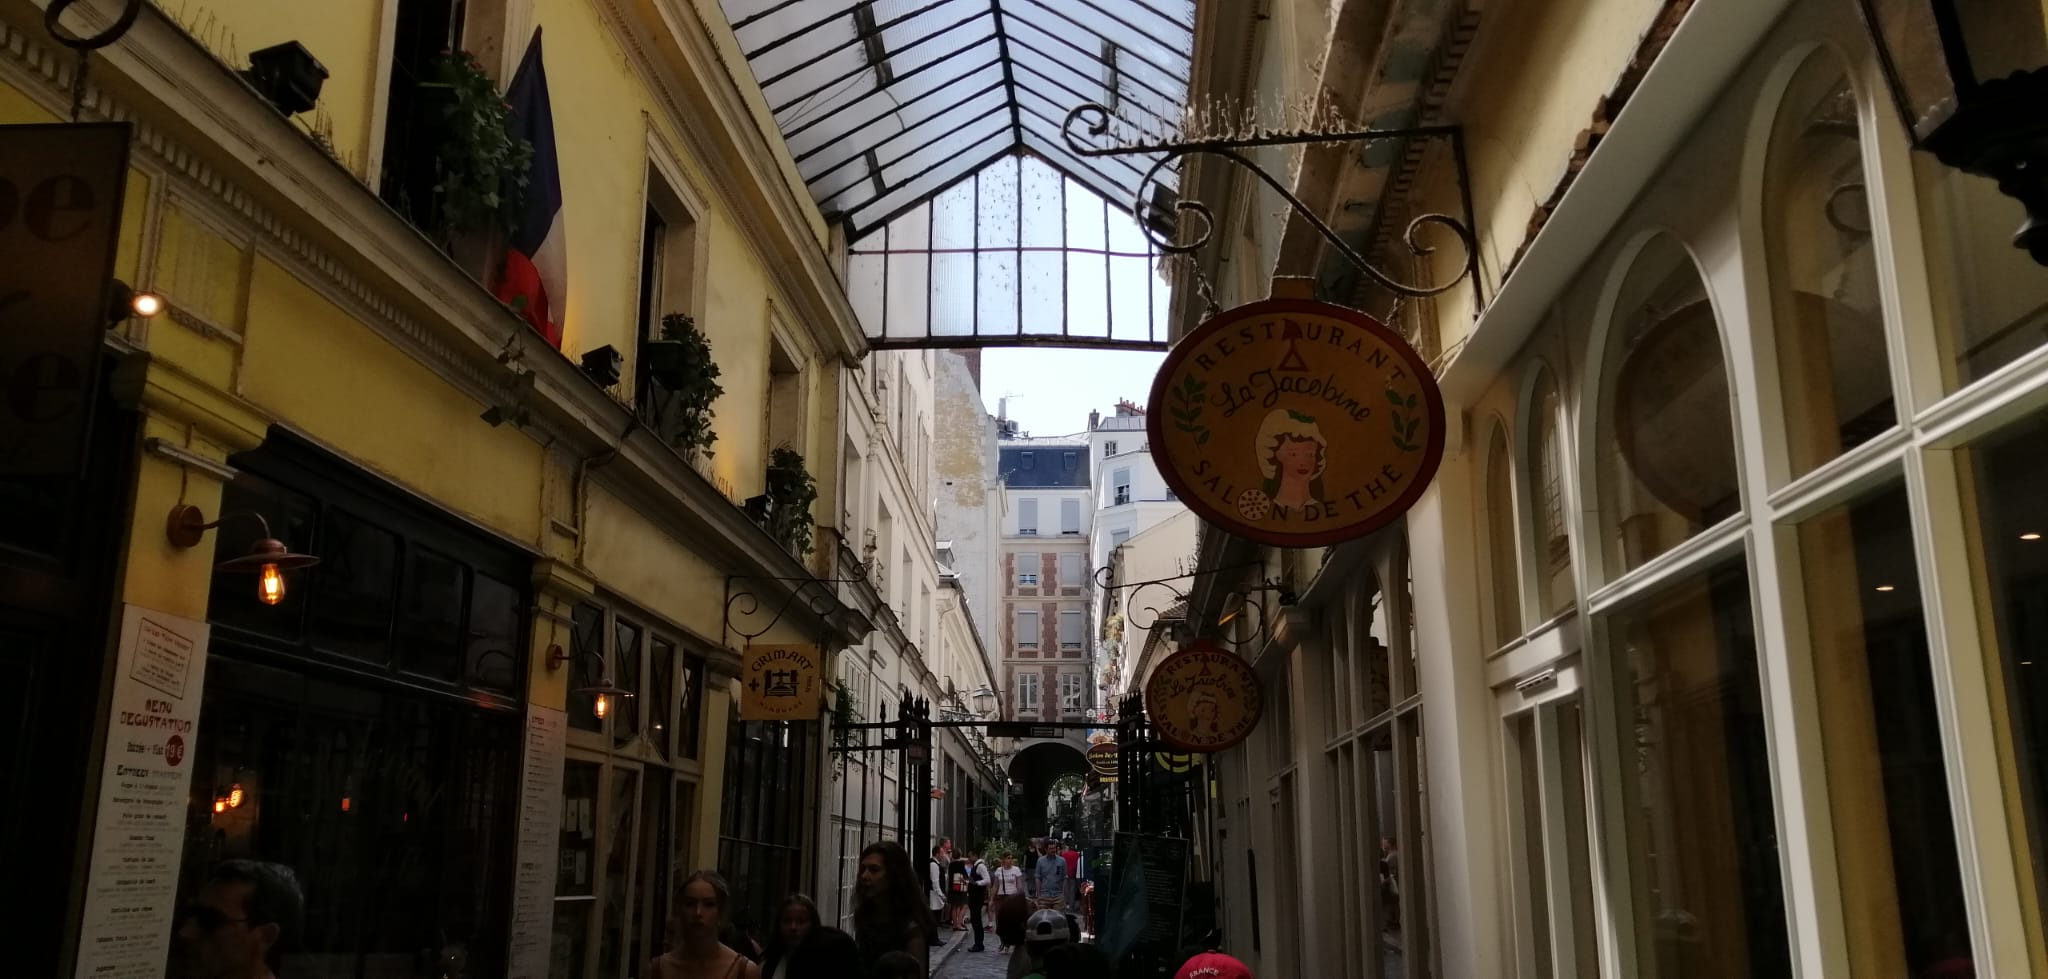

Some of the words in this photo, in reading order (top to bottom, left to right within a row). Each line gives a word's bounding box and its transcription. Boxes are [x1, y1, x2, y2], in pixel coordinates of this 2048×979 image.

[1210, 383, 1254, 417] La
[1249, 368, 1372, 422] Jacobine
[1303, 501, 1339, 523] DE
[1208, 733, 1225, 745] DE
[1189, 967, 1220, 979] FRANCE
